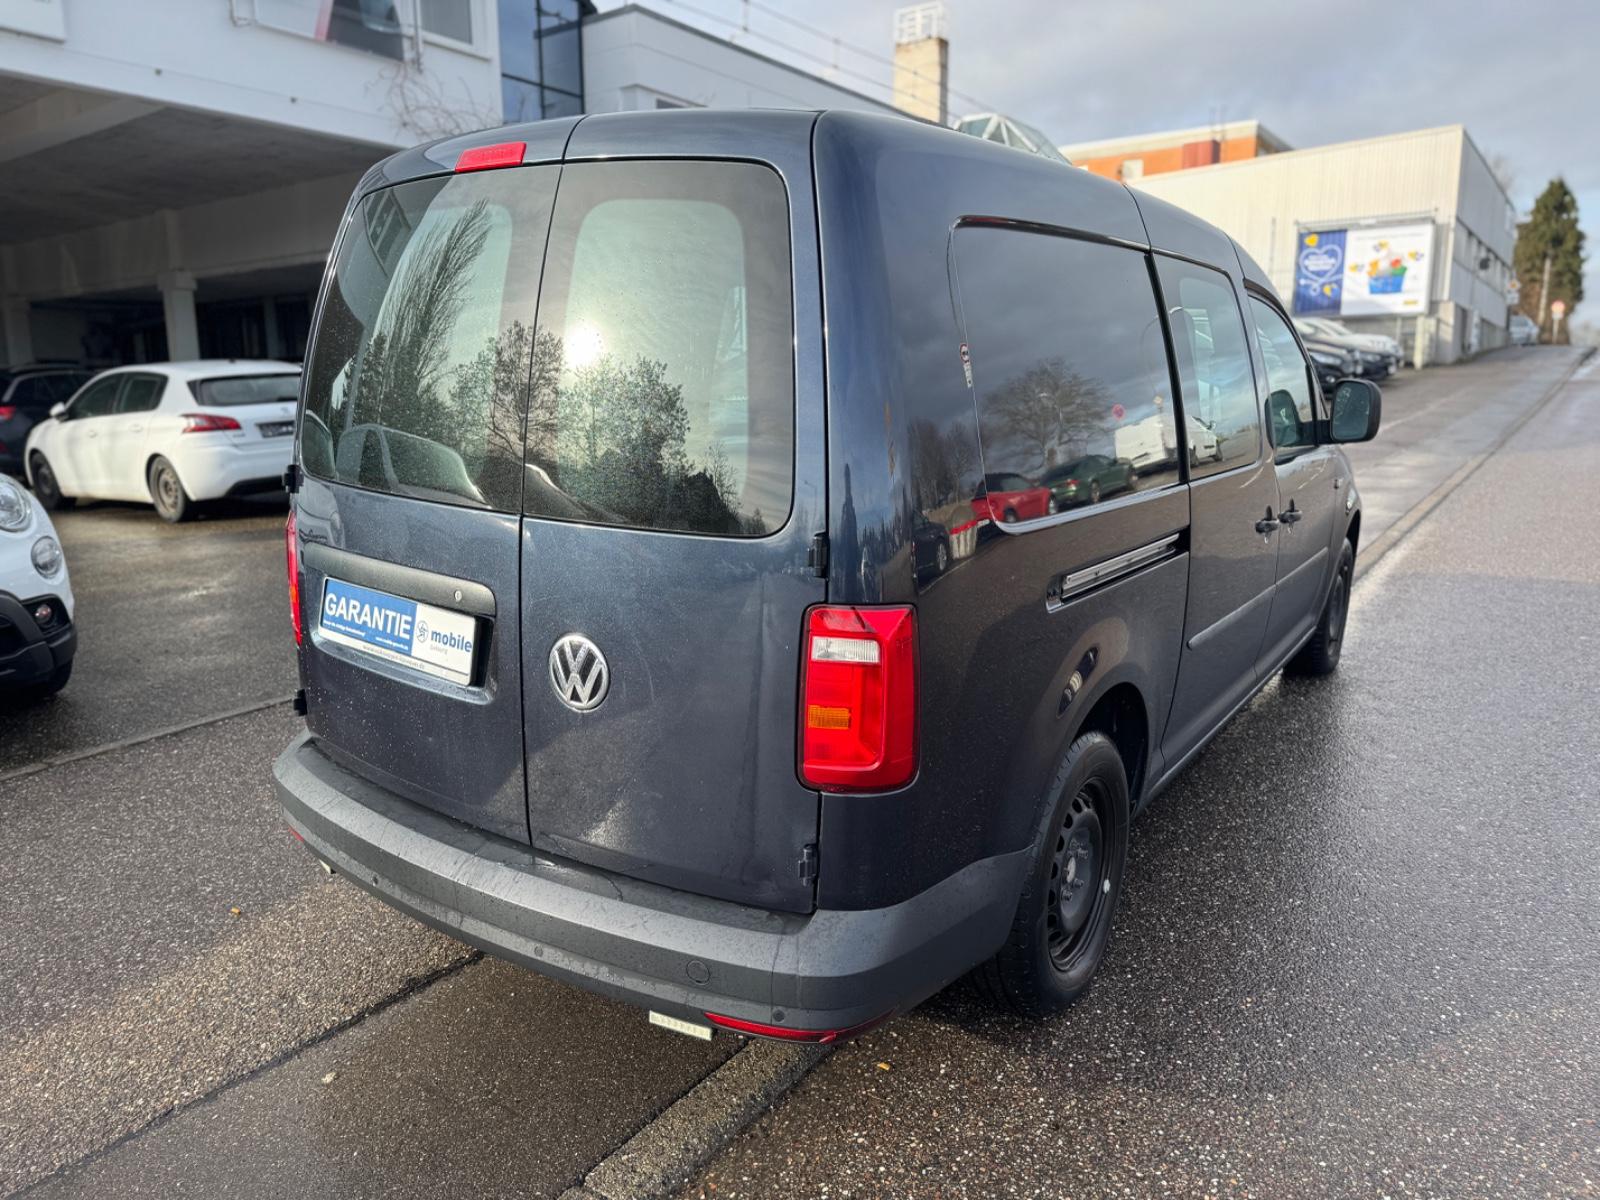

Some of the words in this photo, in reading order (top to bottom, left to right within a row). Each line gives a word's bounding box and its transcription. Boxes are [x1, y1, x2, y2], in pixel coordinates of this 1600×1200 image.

[325, 592, 412, 640] GARANTIE
[430, 630, 473, 653] mobile
[550, 633, 609, 713] VW
